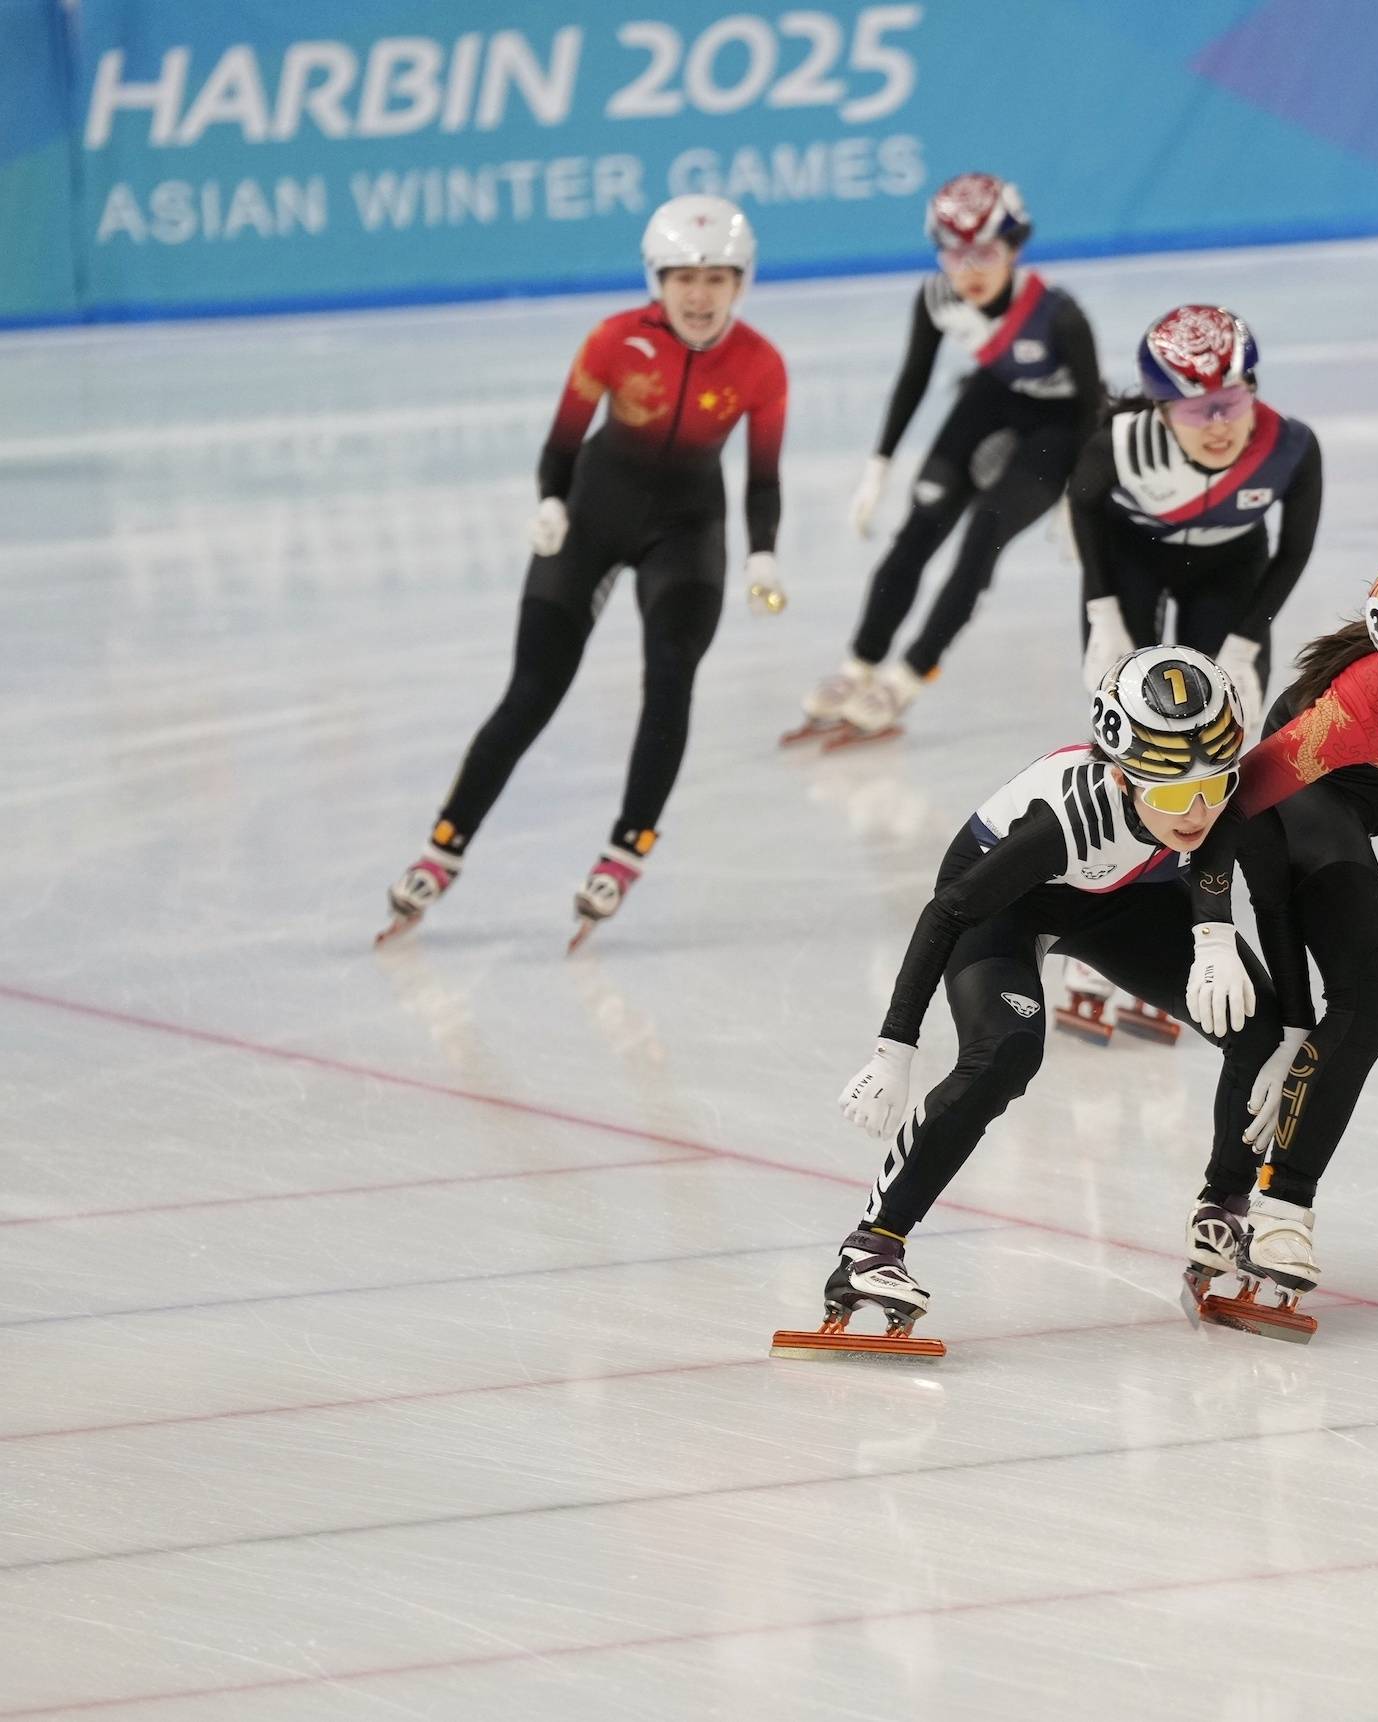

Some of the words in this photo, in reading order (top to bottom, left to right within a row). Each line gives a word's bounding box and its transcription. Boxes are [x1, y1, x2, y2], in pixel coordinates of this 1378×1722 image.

[84, 26, 583, 151] HARBIN
[605, 3, 924, 124] 2025
[97, 176, 328, 245] ASIAN
[349, 154, 643, 232] WINTER
[667, 134, 925, 206] GAMES
[1092, 696, 1122, 749] 28
[1163, 668, 1188, 705] 1
